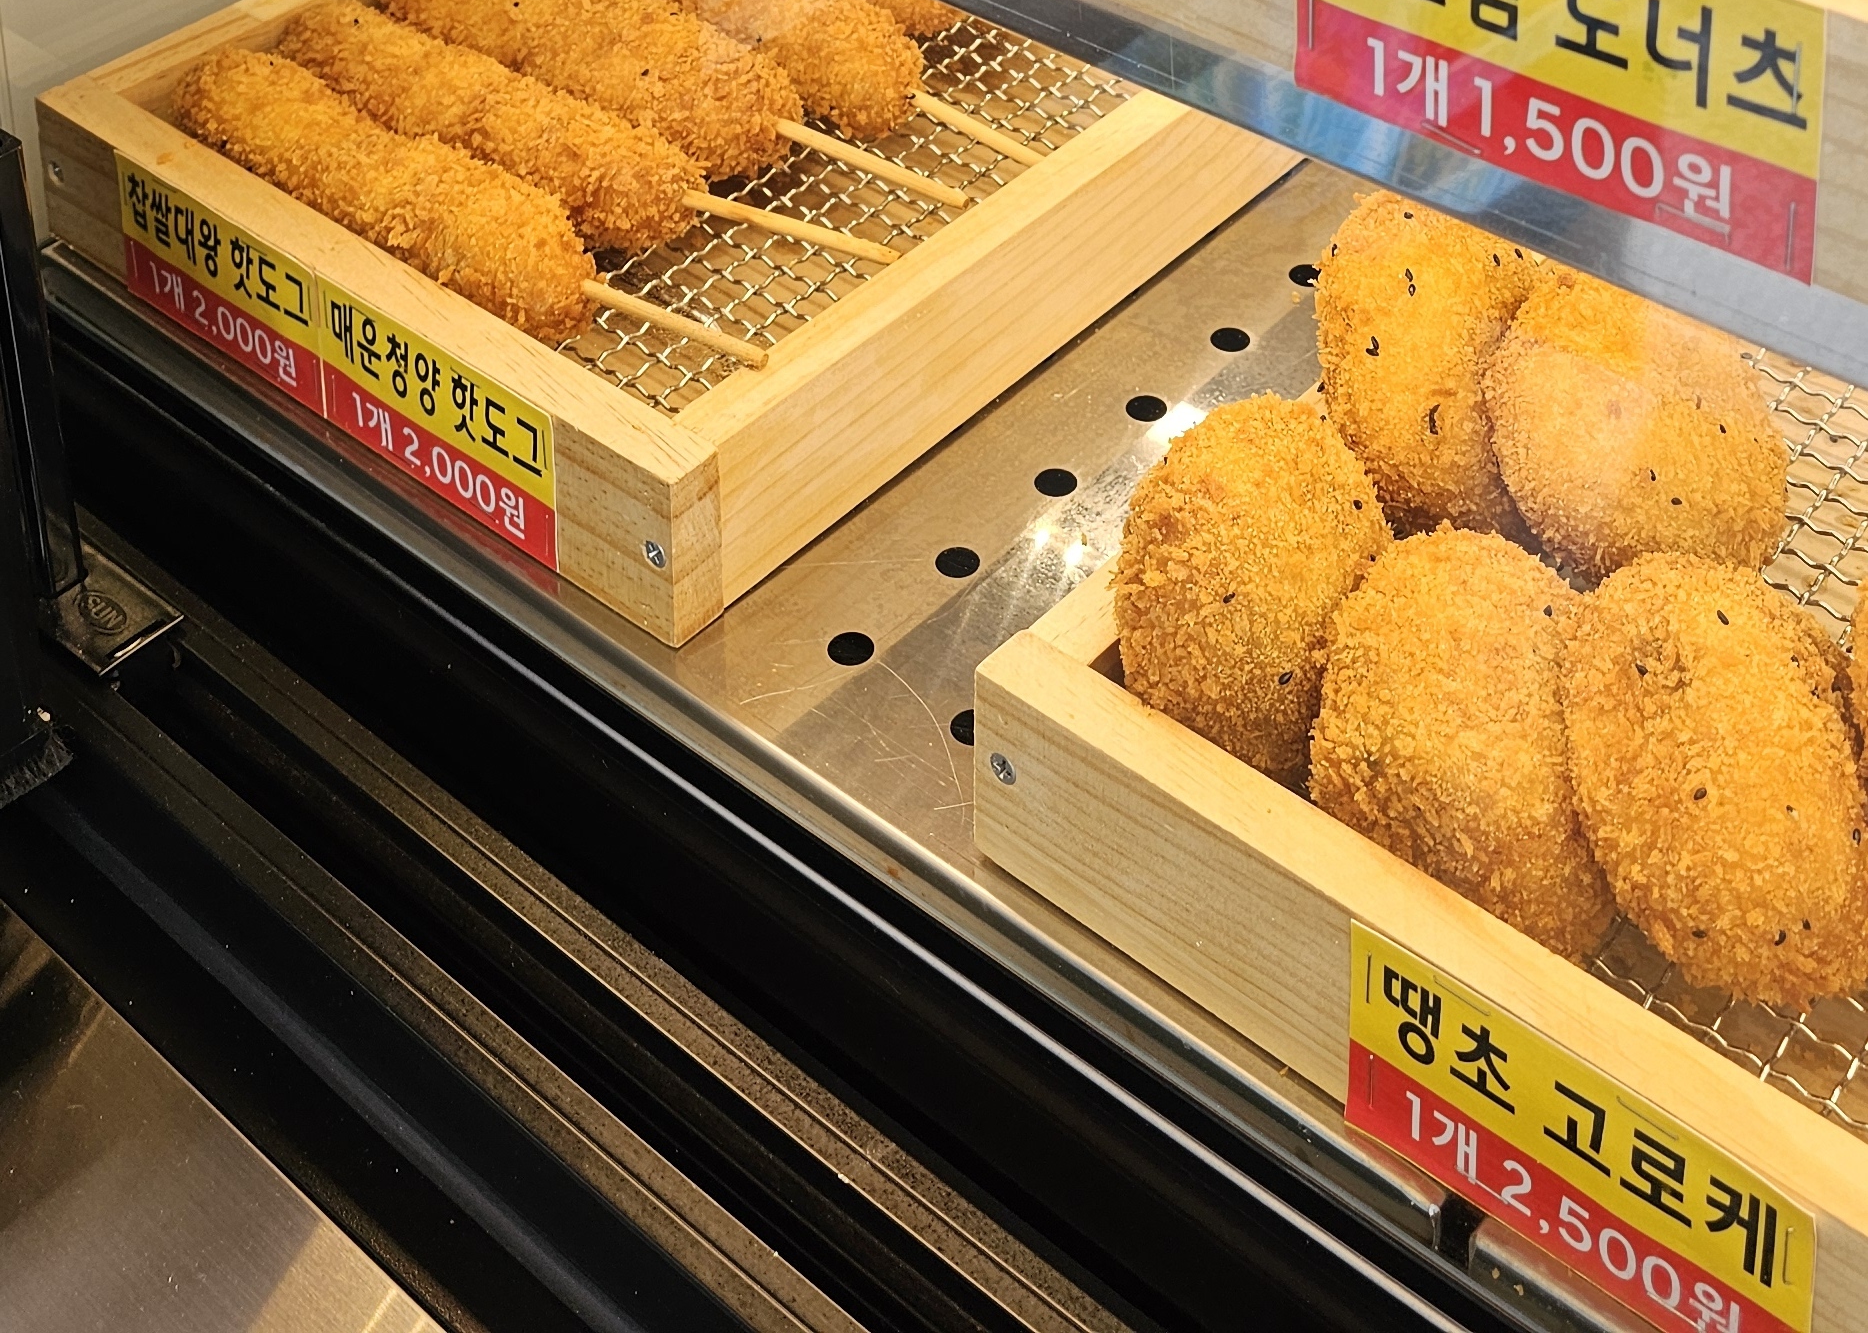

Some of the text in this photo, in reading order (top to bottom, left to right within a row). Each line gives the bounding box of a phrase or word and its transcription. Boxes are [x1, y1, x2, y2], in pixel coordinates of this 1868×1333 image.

[1366, 35, 1732, 221] 1개 1,500원
[127, 173, 309, 328] 찹쌀대왕 핫도그
[149, 261, 297, 388] 1개 2,000원
[331, 299, 543, 478] 매운청양 핫도그
[352, 392, 525, 540] 1개 2,000원
[1383, 965, 1778, 1288] 땡초 고로케
[1405, 1090, 1740, 1333] 1개 2,500원
